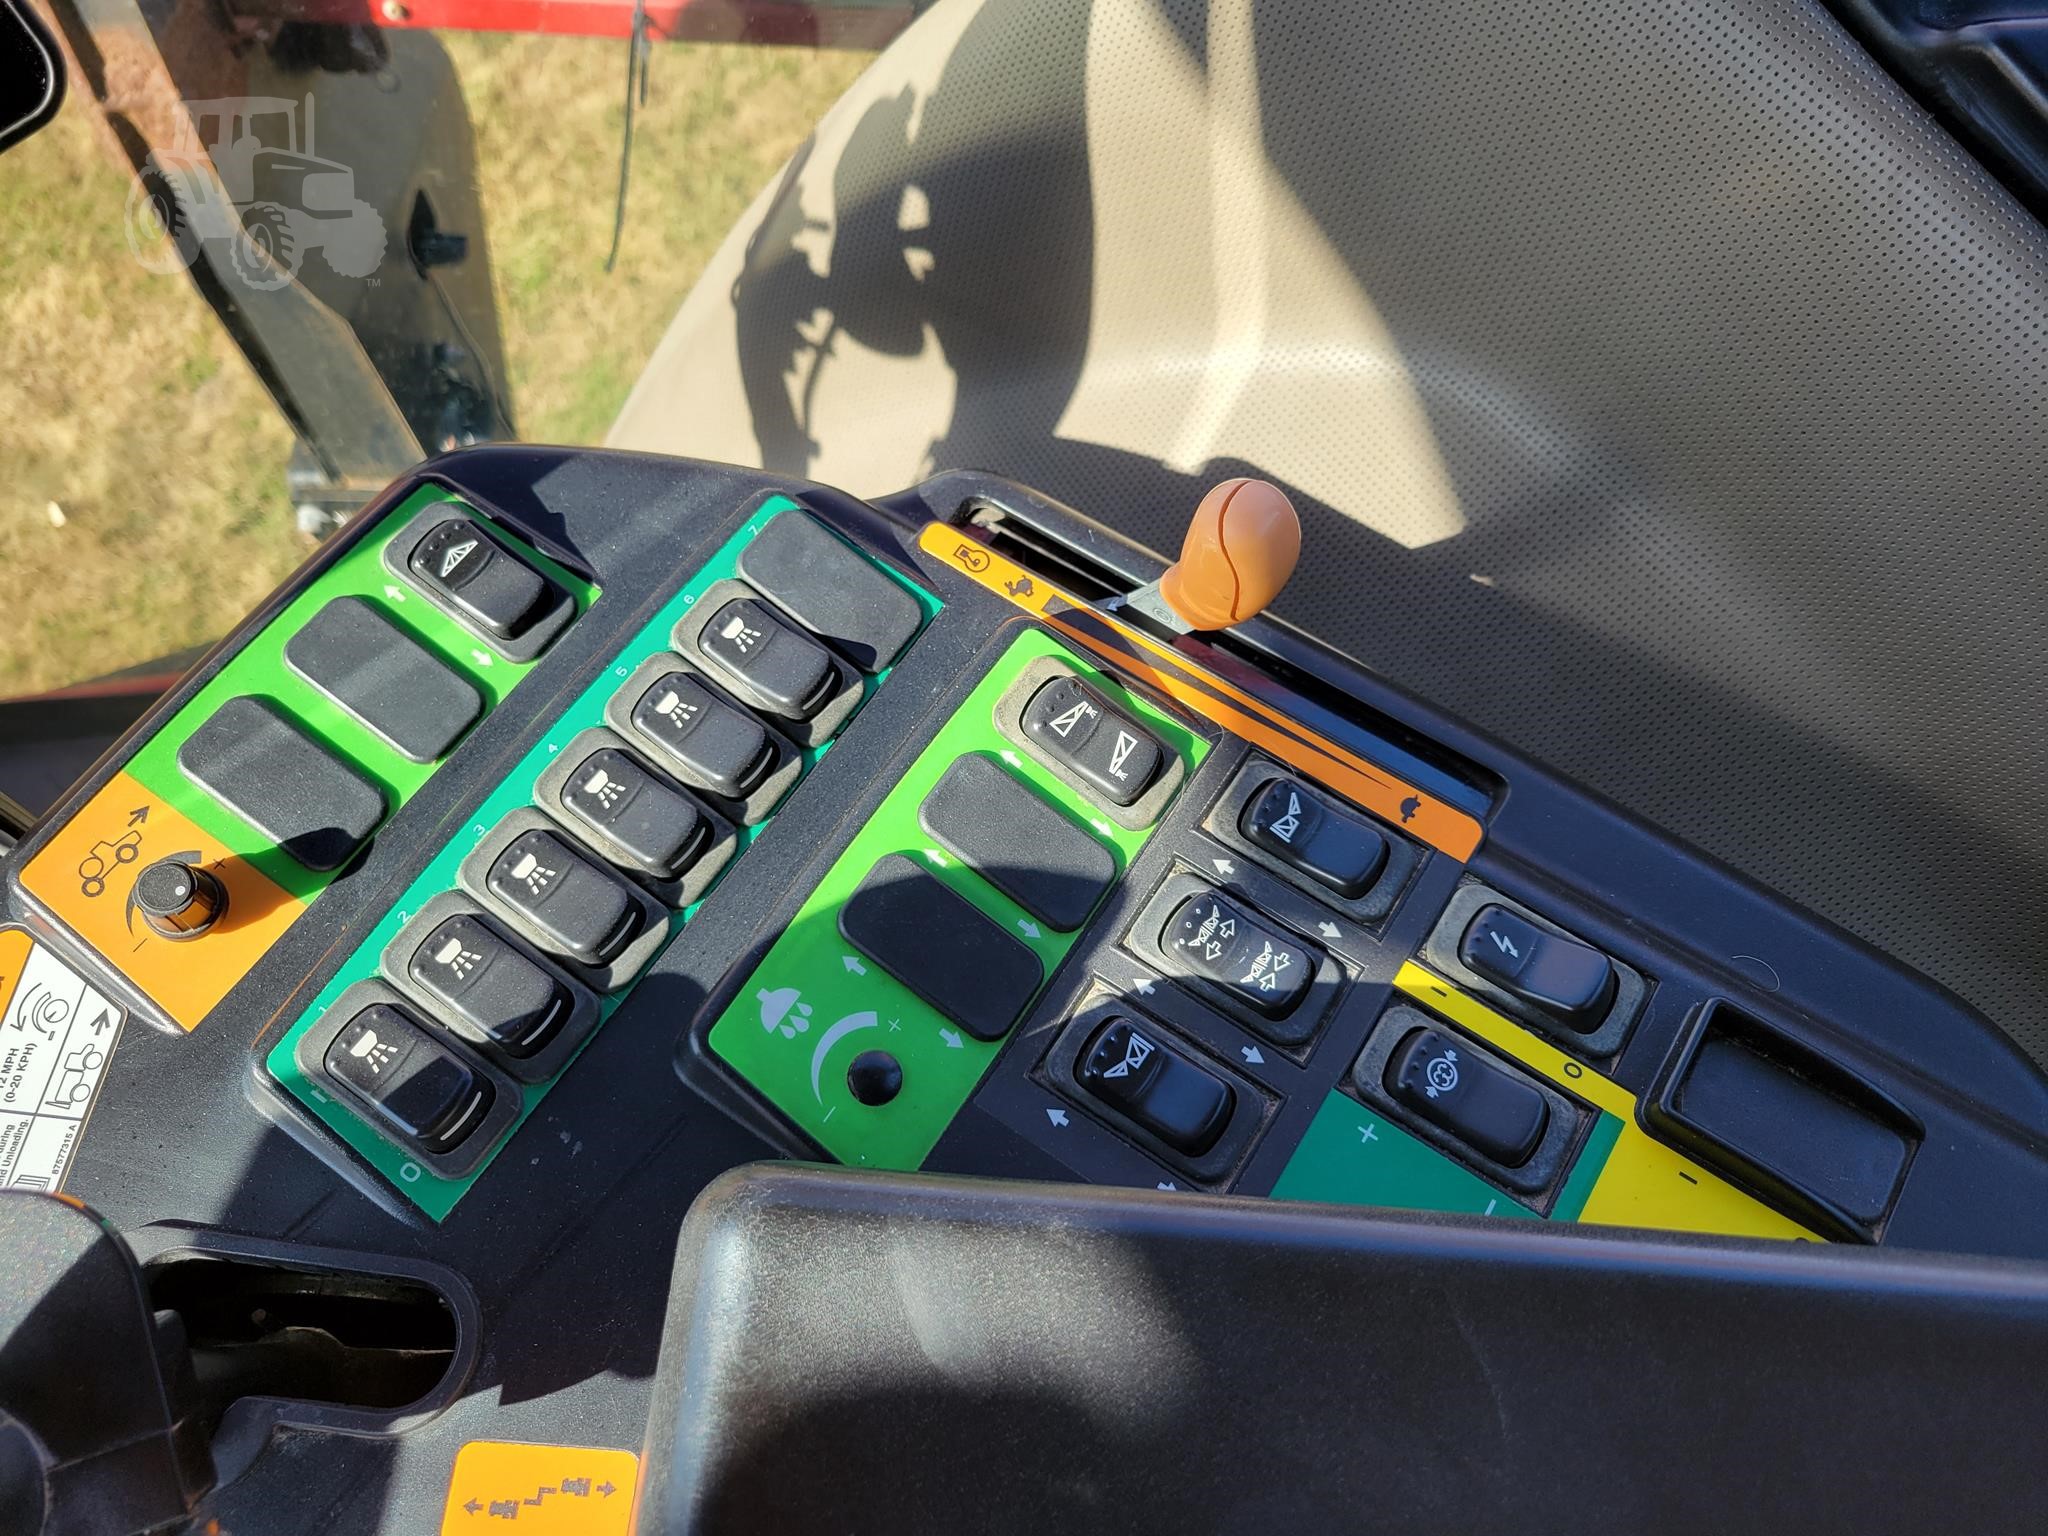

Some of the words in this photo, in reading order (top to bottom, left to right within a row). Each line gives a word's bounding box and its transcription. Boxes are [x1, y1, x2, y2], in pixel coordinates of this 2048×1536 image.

[747, 525, 758, 535] 7
[683, 594, 694, 604] 6
[615, 666, 627, 677] 5
[547, 743, 558, 753] 4
[473, 824, 485, 836] 3
[397, 911, 409, 923] 2
[1, 1048, 19, 1074] MPH
[3, 1075, 23, 1103] (0-20
[16, 1043, 38, 1071] KPH)
[1, 1119, 29, 1167] Unloading.
